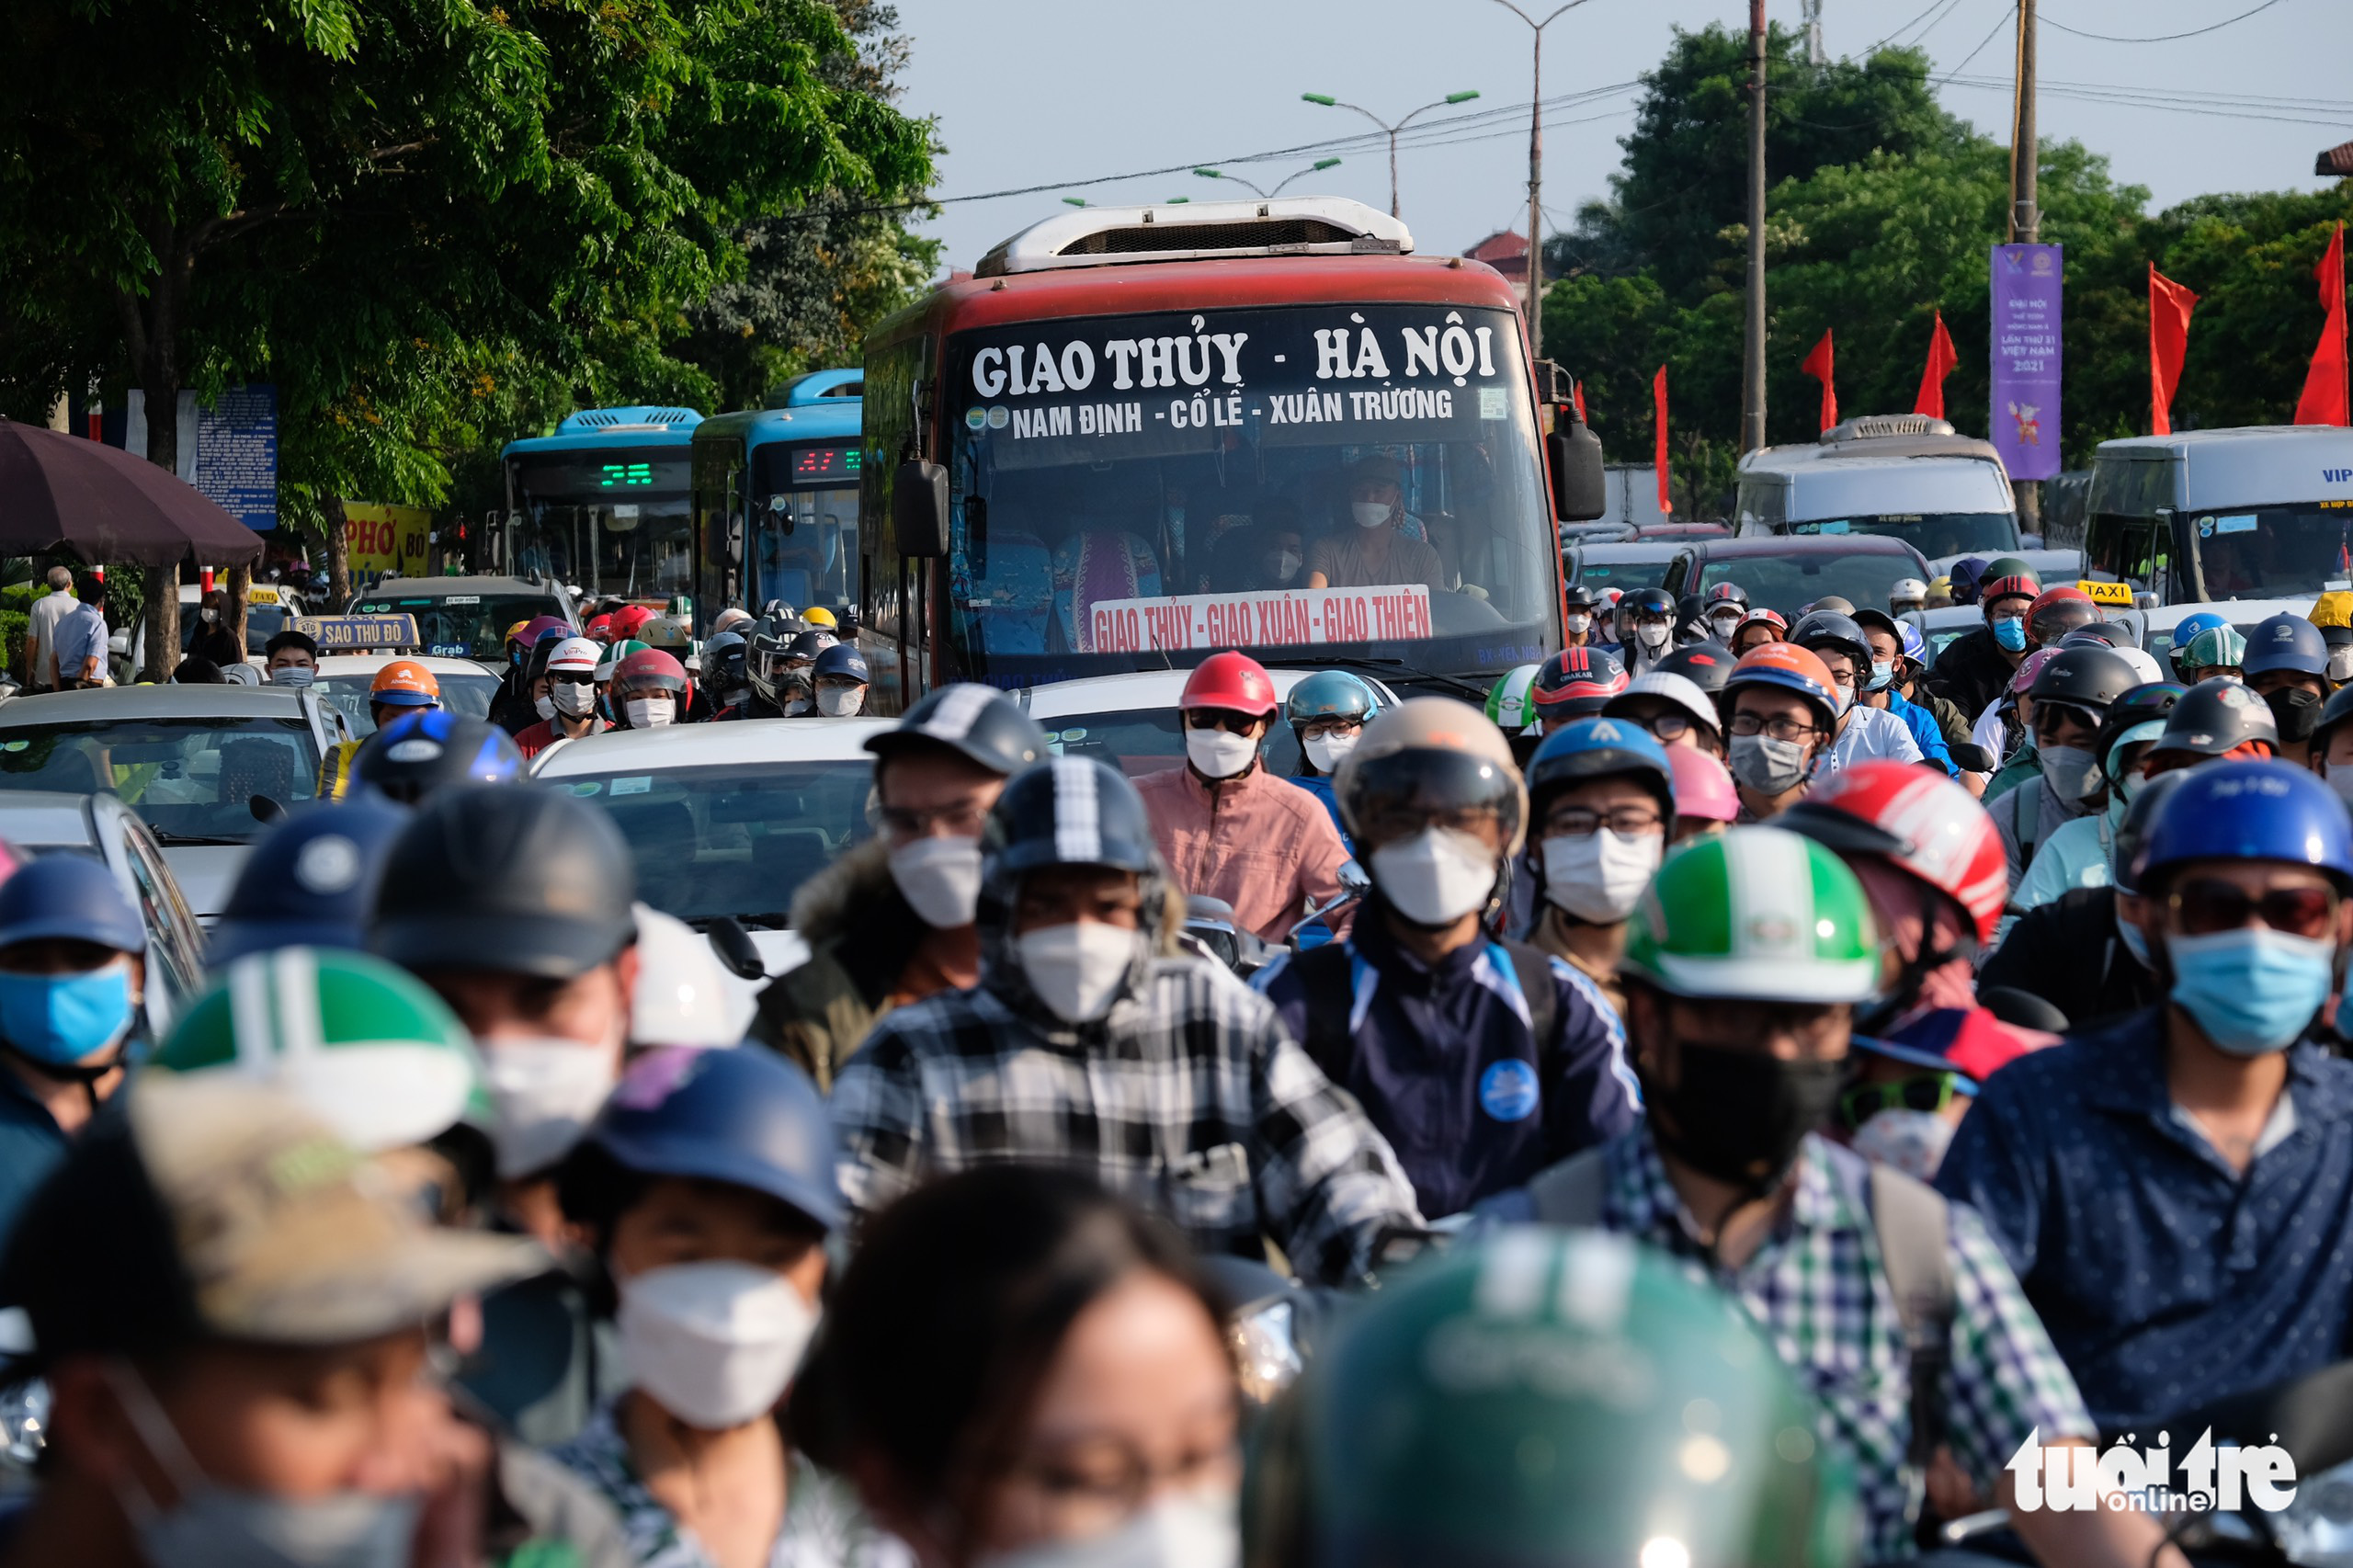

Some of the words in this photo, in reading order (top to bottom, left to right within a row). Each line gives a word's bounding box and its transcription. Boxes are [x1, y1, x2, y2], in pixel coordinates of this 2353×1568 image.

[972, 340, 1096, 397] GIAO
[1105, 314, 1248, 390] THỦY
[1313, 312, 1391, 379] HÀ
[1401, 311, 1495, 387] NỘI
[2029, 347, 2055, 356] NAM
[2013, 359, 2044, 372] 2021
[1012, 406, 1073, 439] NAM
[1079, 403, 1142, 437] ĐỊNH
[1170, 388, 1211, 428] CỔ
[1213, 382, 1245, 426] LỄ
[1269, 386, 1343, 425] XUÂN
[2322, 469, 2353, 483] VIP
[345, 508, 397, 555] PHỞ
[405, 527, 426, 558] BÒ
[2085, 585, 2125, 597] TAXI
[1095, 608, 1141, 654] GIAO
[1144, 596, 1192, 651] THỦY
[1207, 601, 1253, 648] GIAO
[1256, 593, 1312, 647] XUÂN
[1324, 597, 1368, 643] GIAO
[1372, 588, 1430, 642] THIÊN
[325, 625, 352, 643] SAO
[355, 619, 380, 642] THỦ
[383, 621, 402, 642] ĐÔ
[432, 644, 464, 654] Grab
[1560, 671, 1593, 682] OSAKAR
